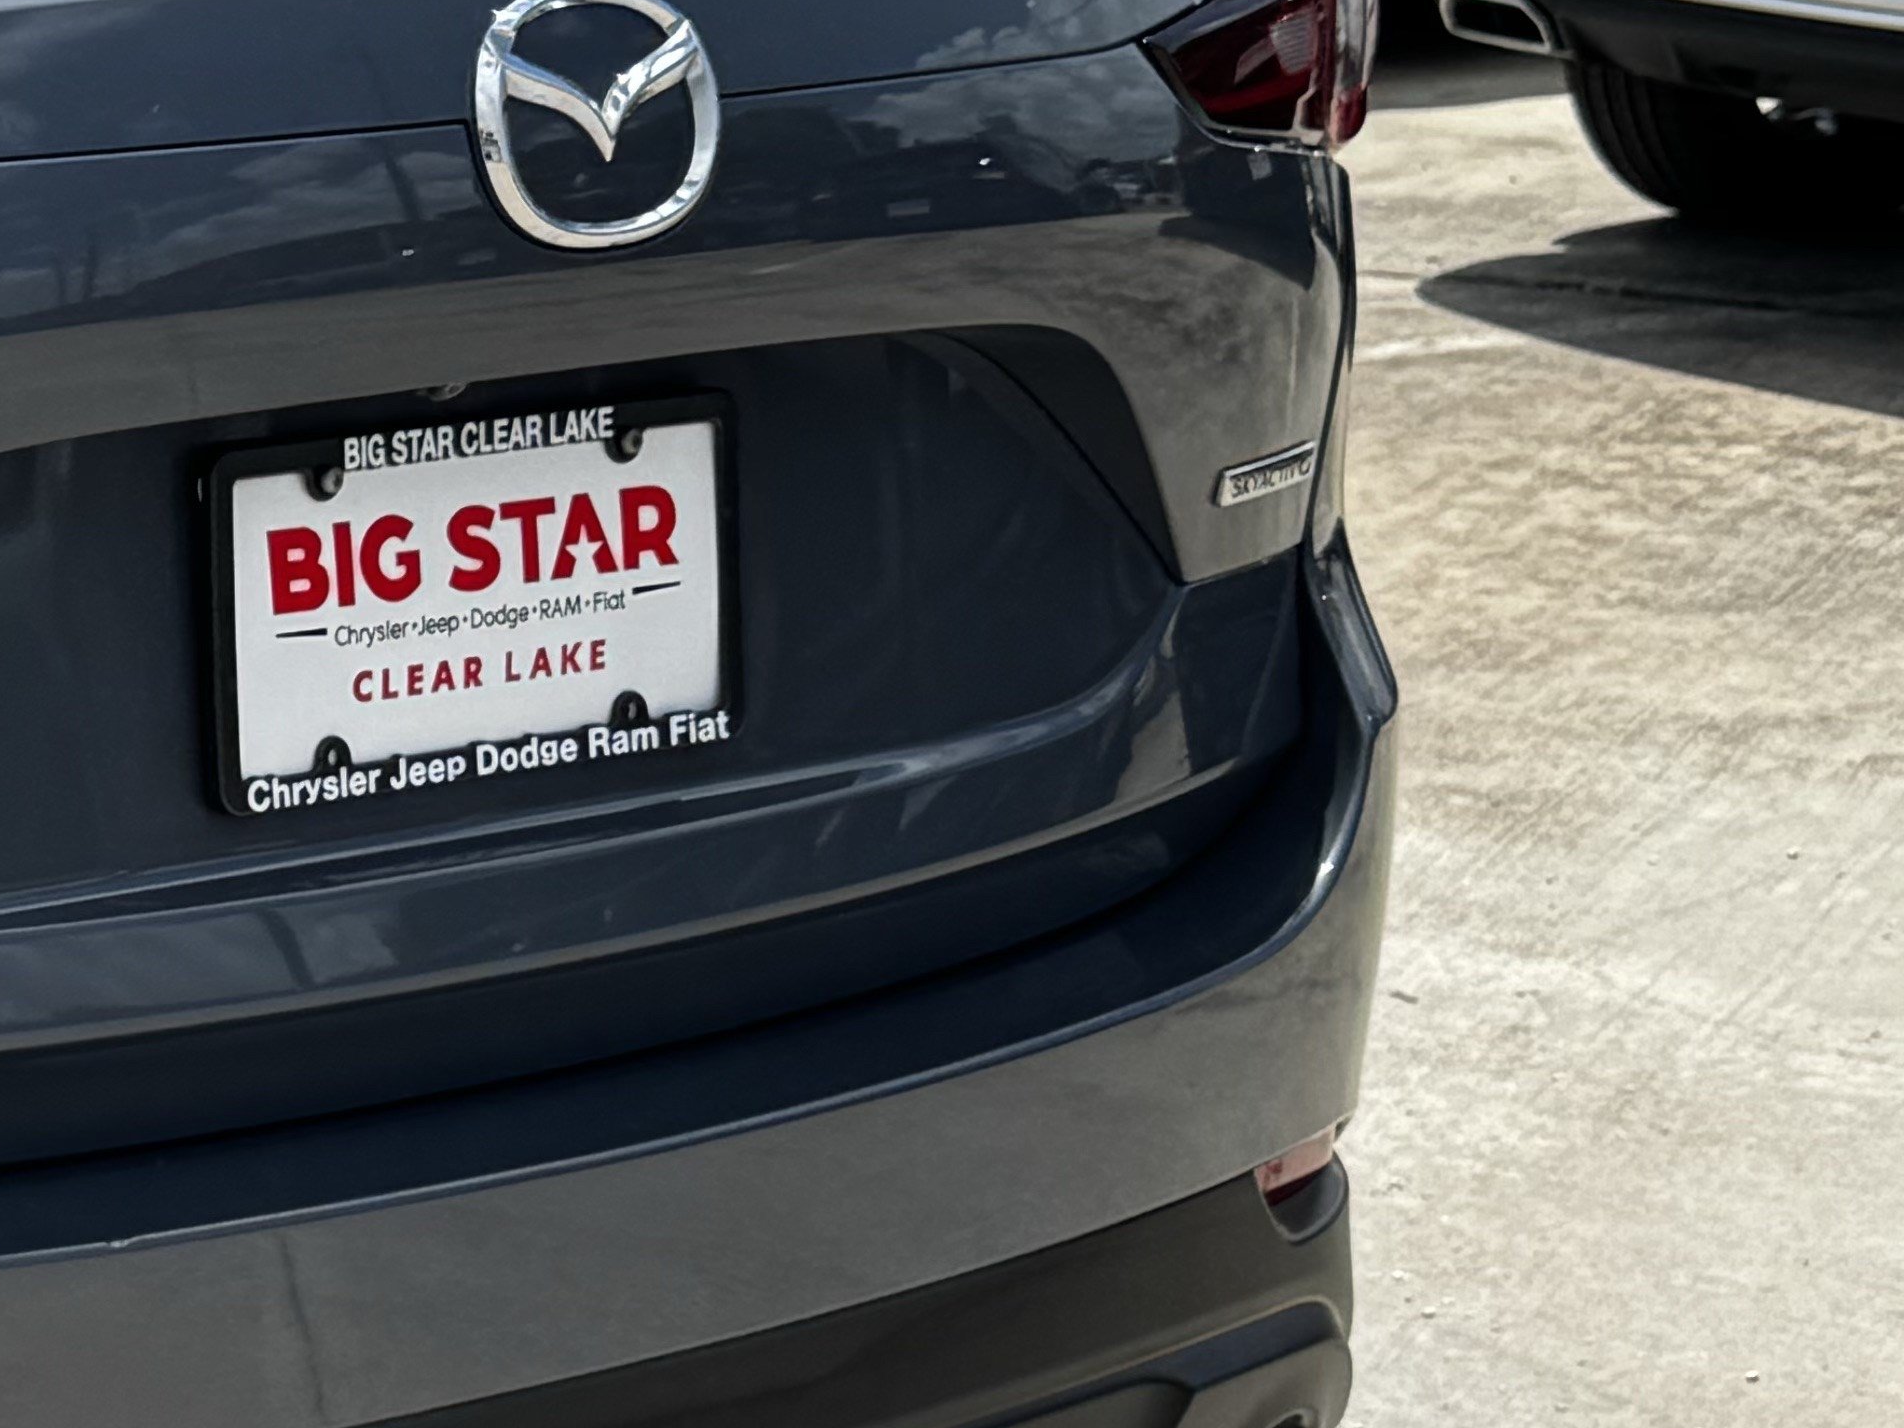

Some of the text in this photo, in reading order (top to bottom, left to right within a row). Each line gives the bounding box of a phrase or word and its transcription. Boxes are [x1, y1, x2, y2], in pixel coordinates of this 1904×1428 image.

[344, 406, 615, 470] BIG STAR CLEAR LAKE
[267, 484, 680, 616] BIG STAR
[351, 638, 608, 703] CLEAR LAKE
[246, 709, 731, 815] Chrysler Jeep Dodge Ram Fiat
